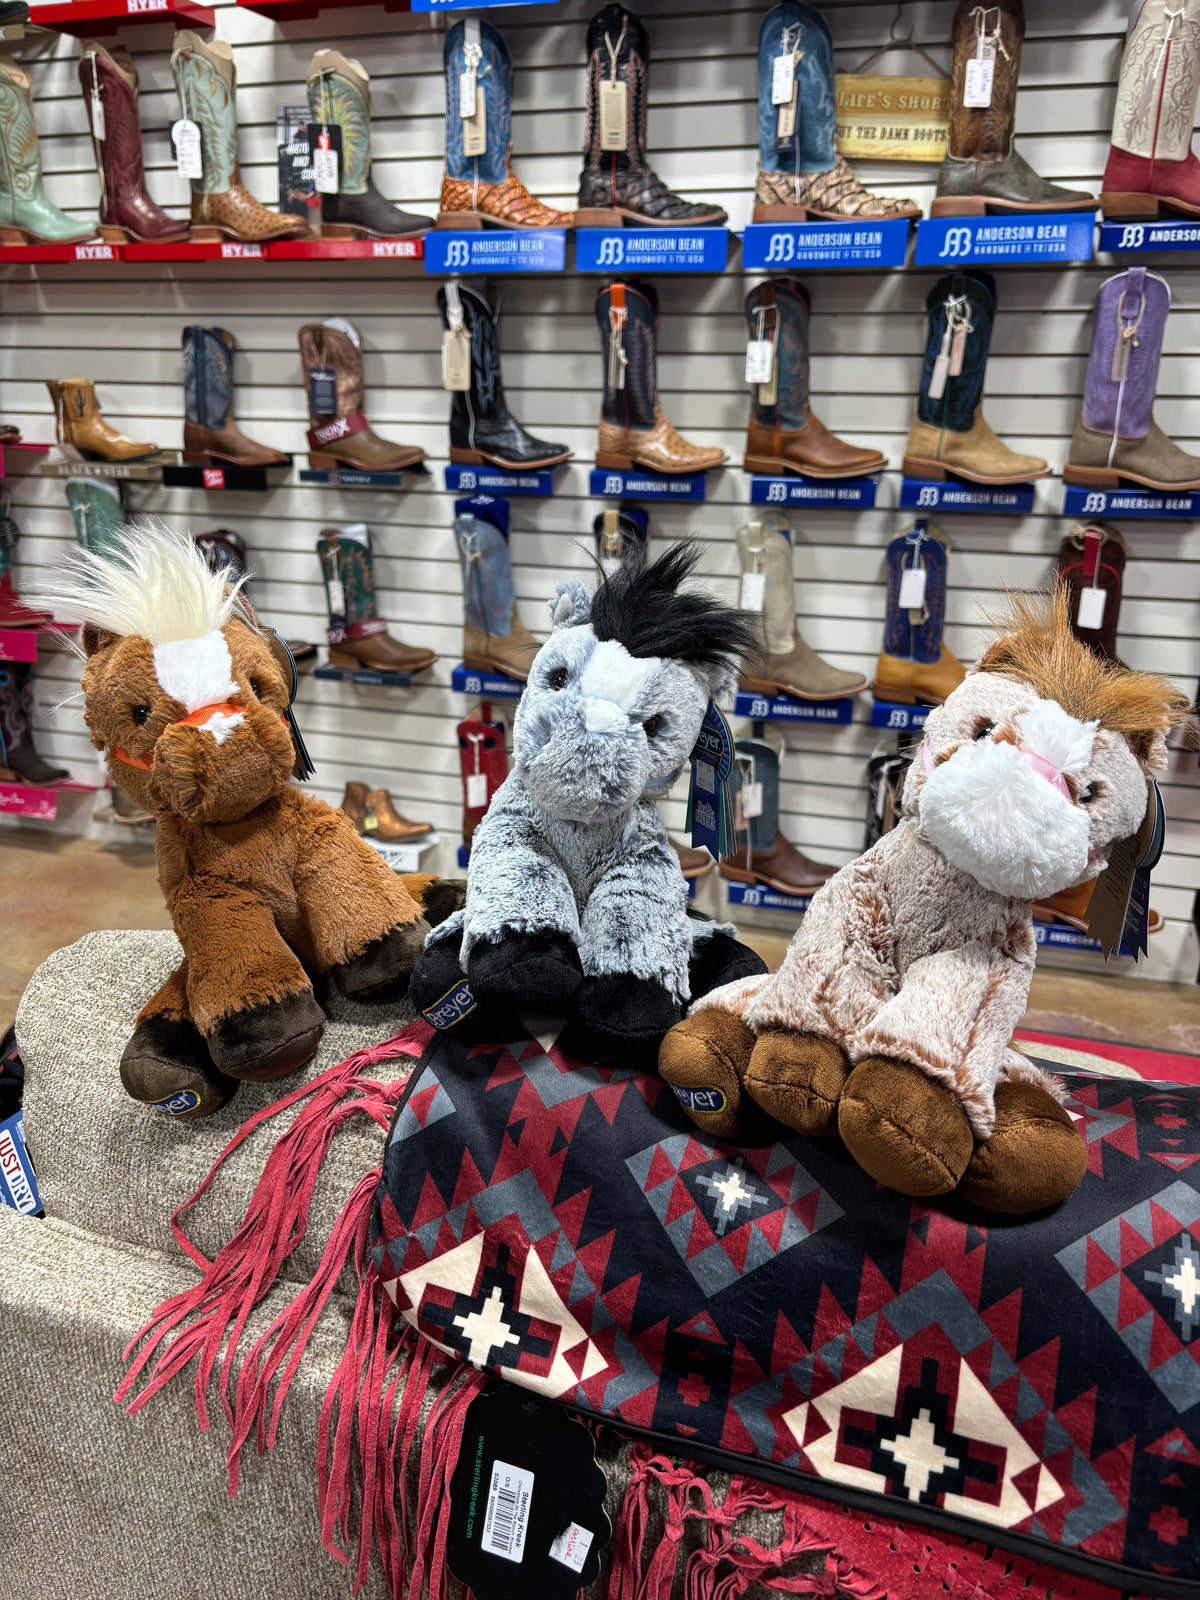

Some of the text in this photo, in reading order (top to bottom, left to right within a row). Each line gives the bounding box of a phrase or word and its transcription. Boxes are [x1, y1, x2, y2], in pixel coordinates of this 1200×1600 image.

[128, 0, 169, 13] HYER
[838, 91, 892, 110] LIFE'S
[856, 126, 877, 140] THE
[880, 127, 910, 141] DAMN
[912, 128, 947, 142] BOOTS
[798, 233, 853, 246] ANDERSON
[854, 232, 883, 246] BEAN
[976, 226, 1035, 242] ANDERSON
[1036, 225, 1068, 239] BEAN
[1149, 229, 1200, 242] ANDERSO
[221, 243, 263, 258] HYER
[373, 241, 416, 257] HYER
[471, 241, 519, 253] ANDERSON
[520, 239, 545, 252] BEAN
[626, 238, 677, 251] ANDERSON
[678, 238, 705, 251] BEAN
[75, 245, 114, 259] HYER
[479, 476, 517, 487] ANDERSON
[518, 477, 540, 488] BEAN
[626, 481, 667, 492] ANDERSON
[668, 482, 691, 493] BEAN
[790, 487, 836, 499] ANDERSON
[837, 488, 862, 500] BEAN
[942, 491, 991, 504] ANDERSON
[992, 493, 1018, 505] BEAN
[1110, 497, 1164, 510] ANDERSON
[1165, 498, 1193, 510] BEAN
[772, 704, 815, 717] ANDERSON
[816, 708, 838, 719] BEAN
[425, 984, 474, 1028] Breyer
[149, 1090, 191, 1114] eyer
[673, 1086, 718, 1109] eyer
[466, 1435, 485, 1539] www.sterlingkreek.com
[515, 1491, 529, 1549] Sterling Kreek
